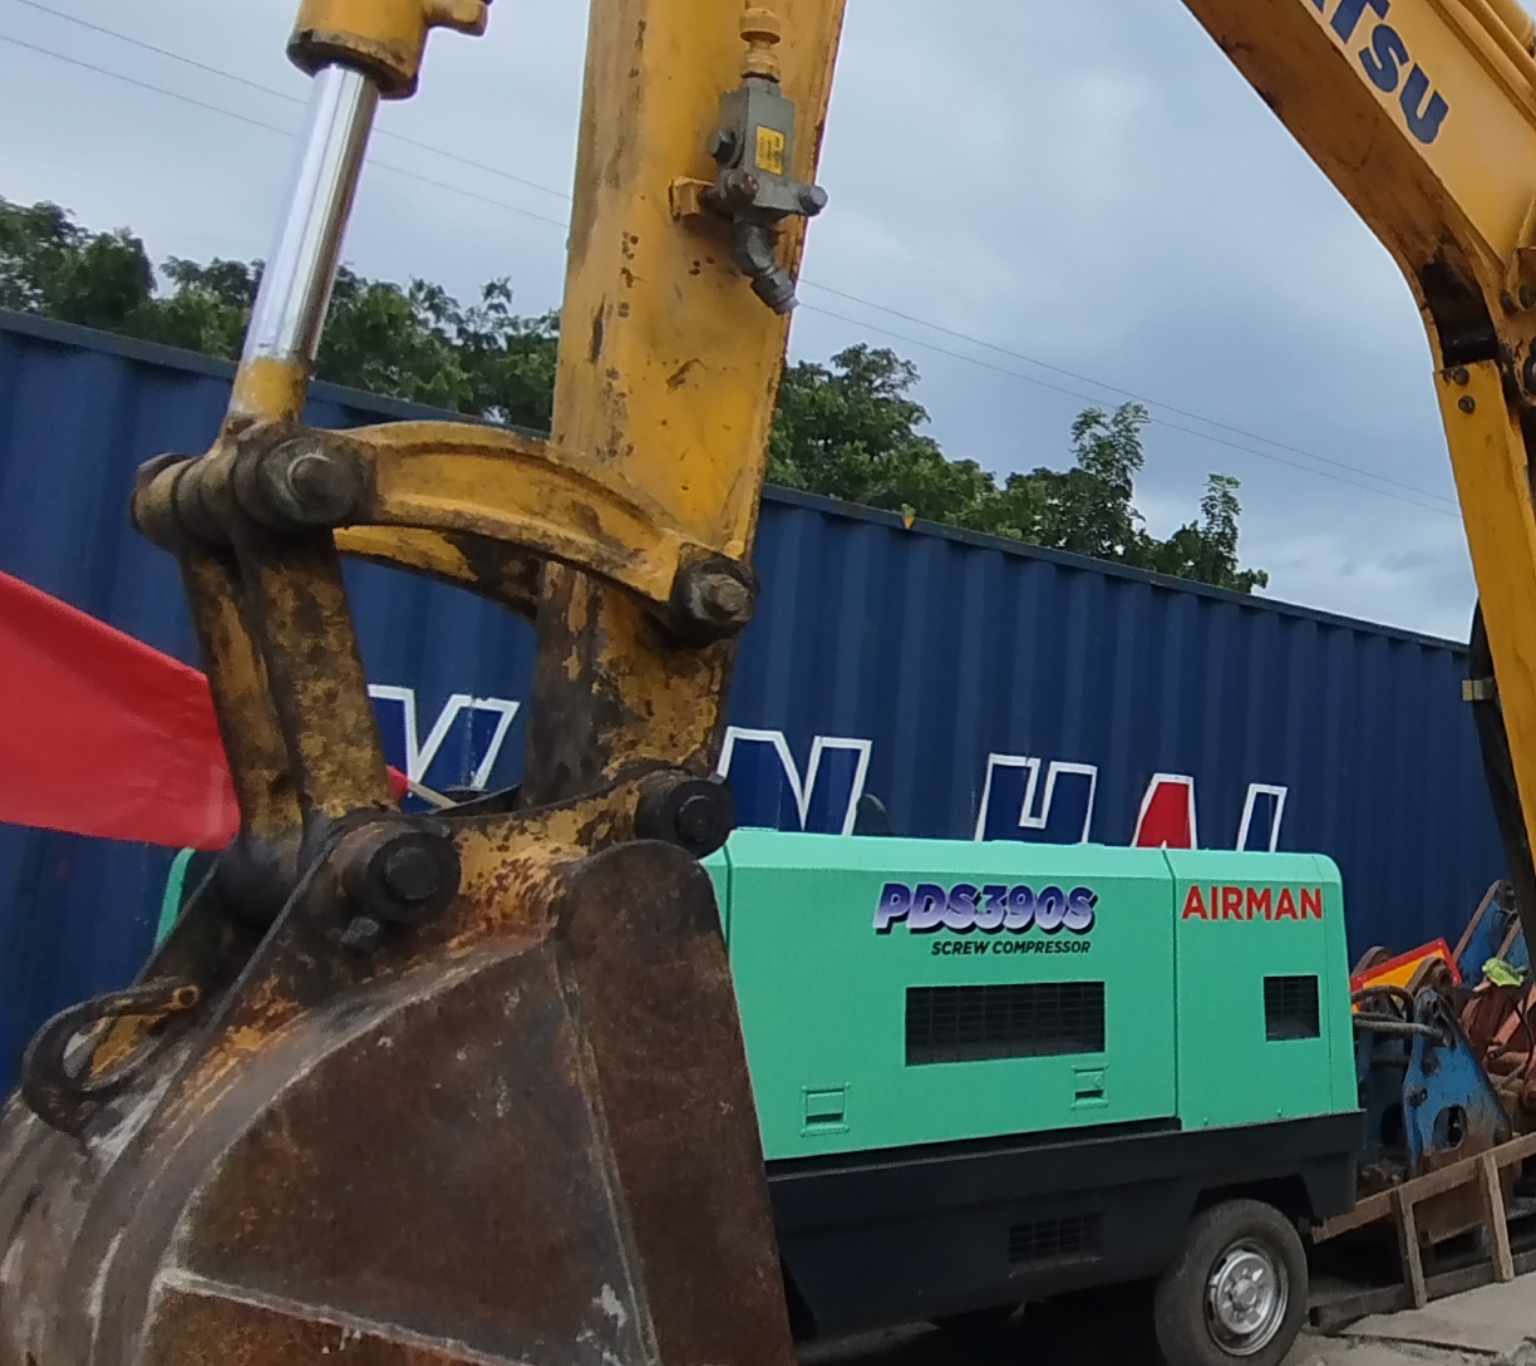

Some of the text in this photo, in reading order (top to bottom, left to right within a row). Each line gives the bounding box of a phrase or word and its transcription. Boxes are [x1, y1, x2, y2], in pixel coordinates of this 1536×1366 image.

[872, 881, 1098, 935] PDS390S
[1181, 885, 1323, 921] AIRMAN
[930, 940, 1091, 956] SCREW COMPRESSOR
